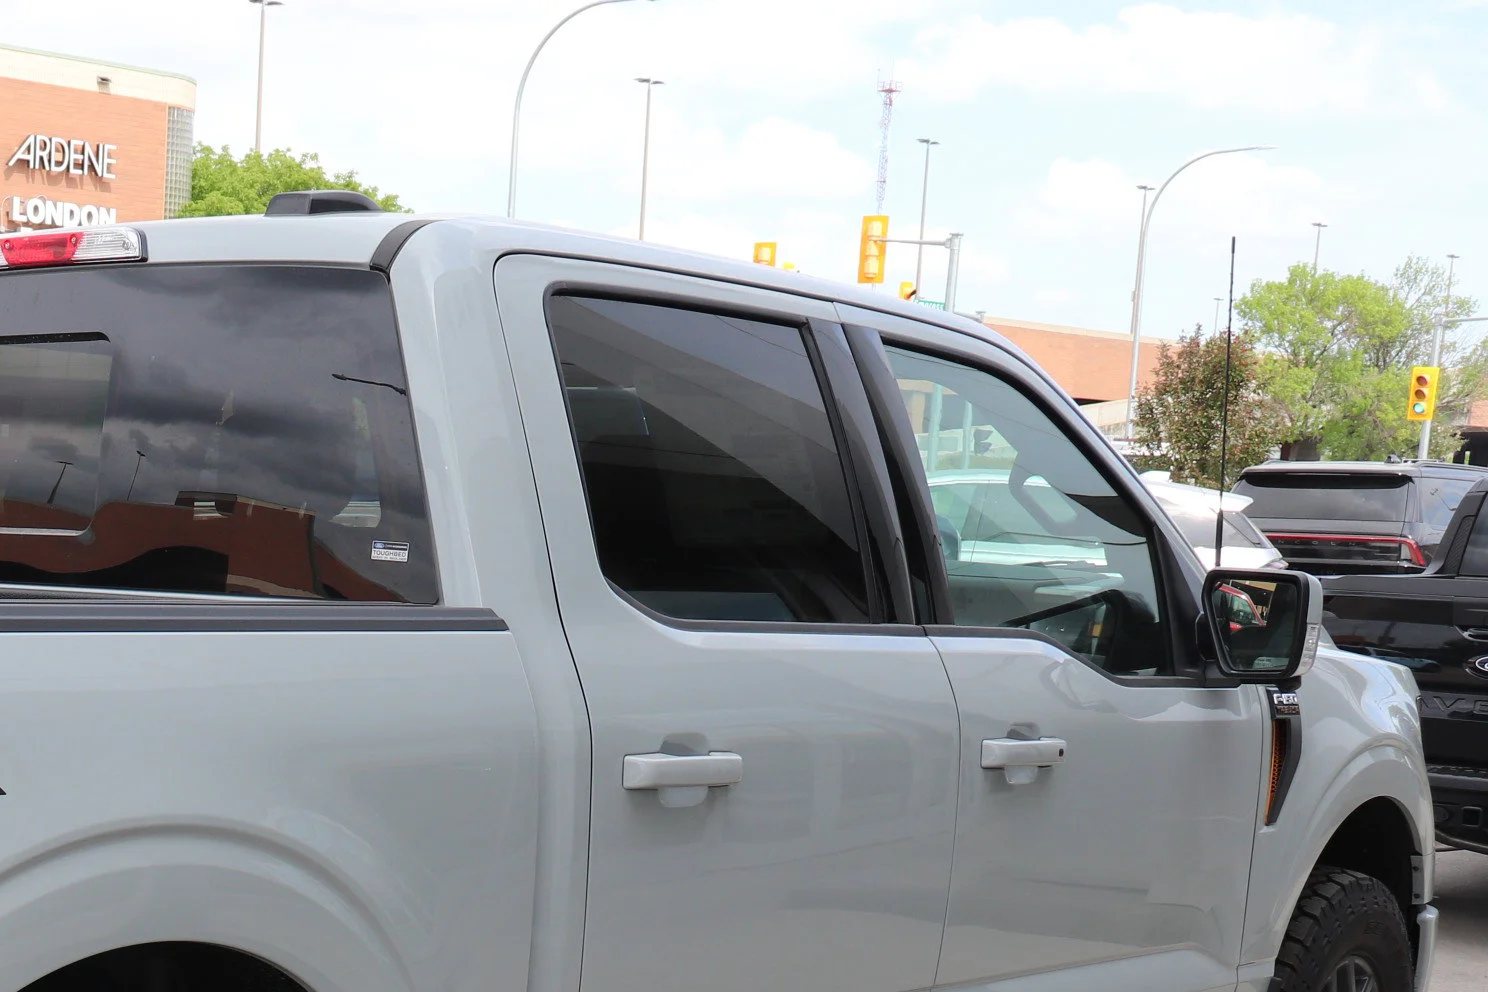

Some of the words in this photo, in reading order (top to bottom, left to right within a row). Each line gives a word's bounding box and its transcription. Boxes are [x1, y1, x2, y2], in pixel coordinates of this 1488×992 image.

[7, 134, 118, 179] ARDENE
[12, 196, 117, 227] LONDON
[373, 549, 407, 558] TOUGHBED
